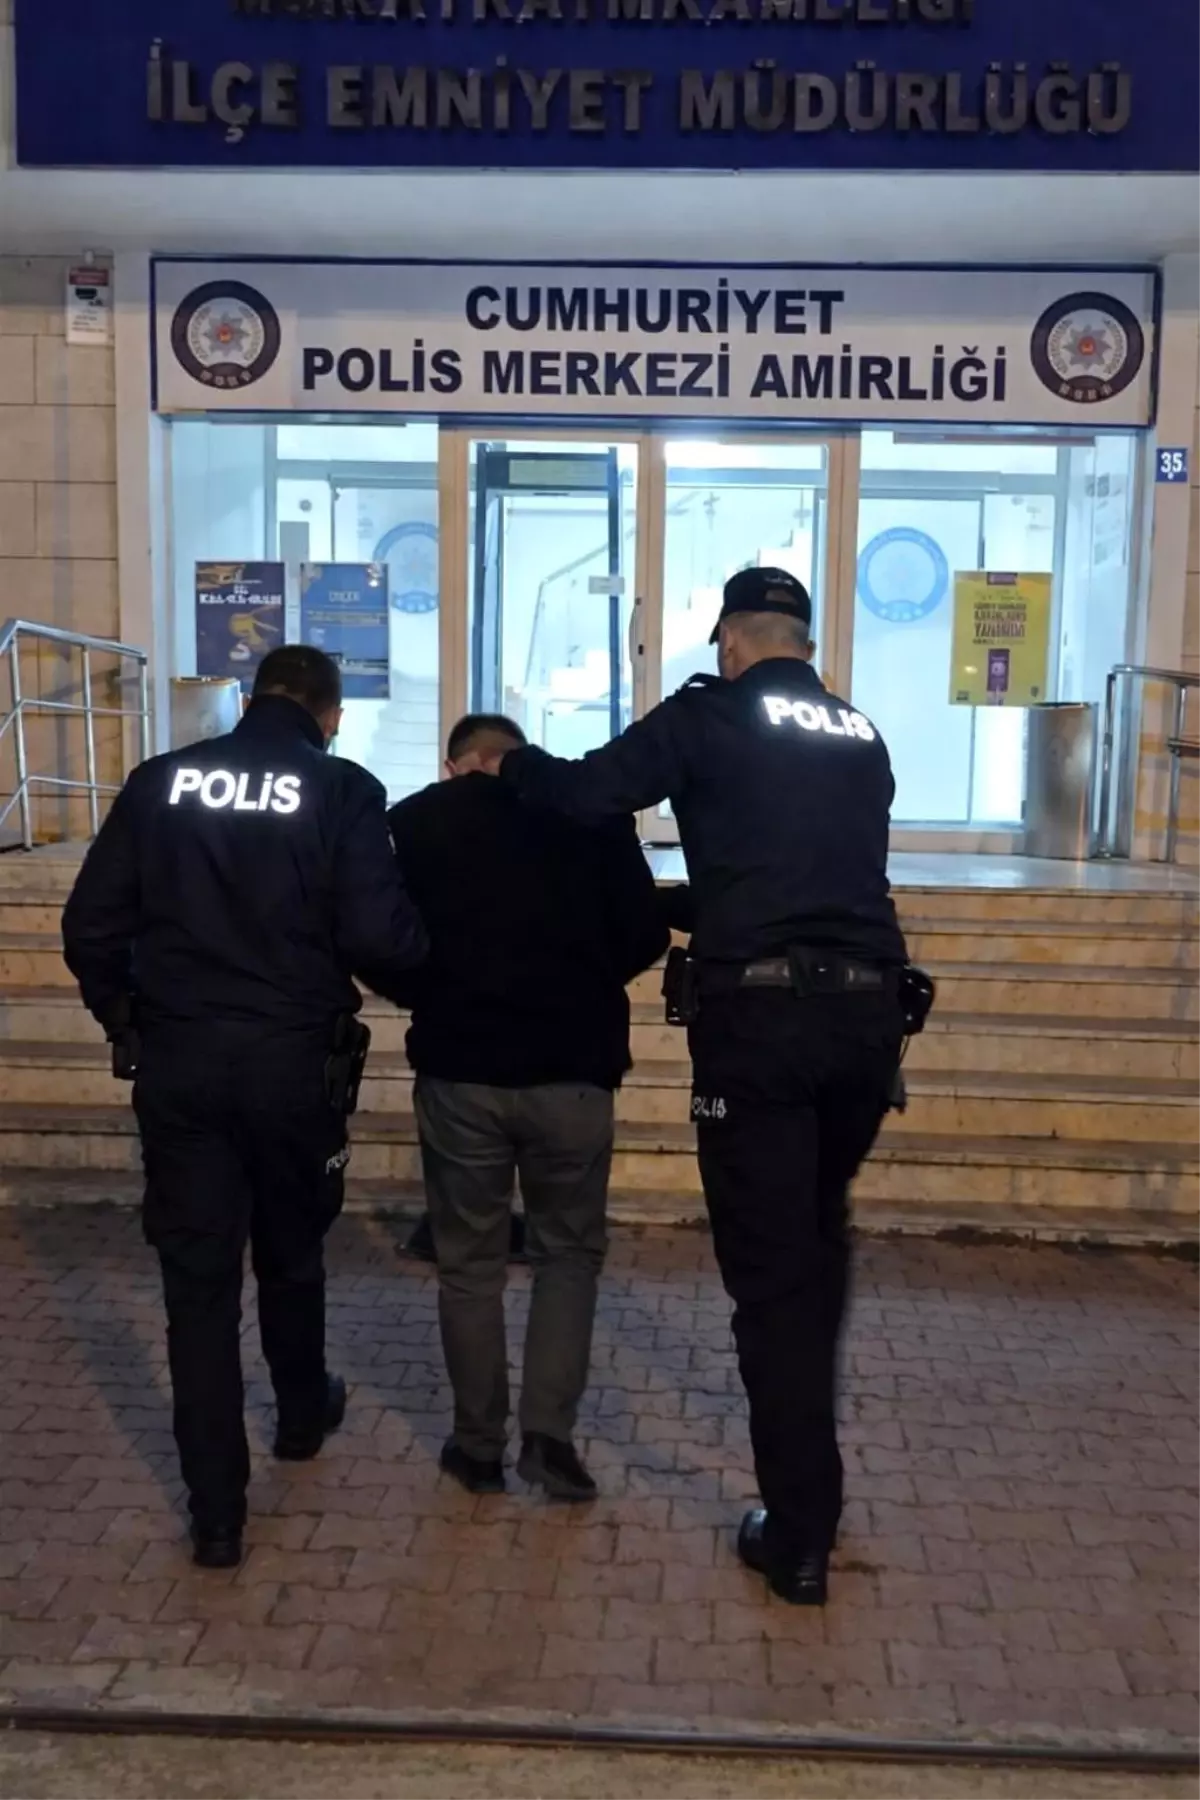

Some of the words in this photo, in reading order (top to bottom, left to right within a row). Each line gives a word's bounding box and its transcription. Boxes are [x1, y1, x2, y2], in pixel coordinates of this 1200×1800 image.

[146, 38, 298, 142] İLÇE
[326, 56, 653, 133] EMNİYET
[679, 60, 1132, 135] MÜDÜRLÜĞÜ
[465, 278, 845, 335] CUMHURİYET
[303, 339, 463, 393] POLİS
[482, 343, 731, 398] MERKEZİ
[749, 344, 1007, 403] AMİRLİĞİ
[1160, 451, 1183, 473] 35
